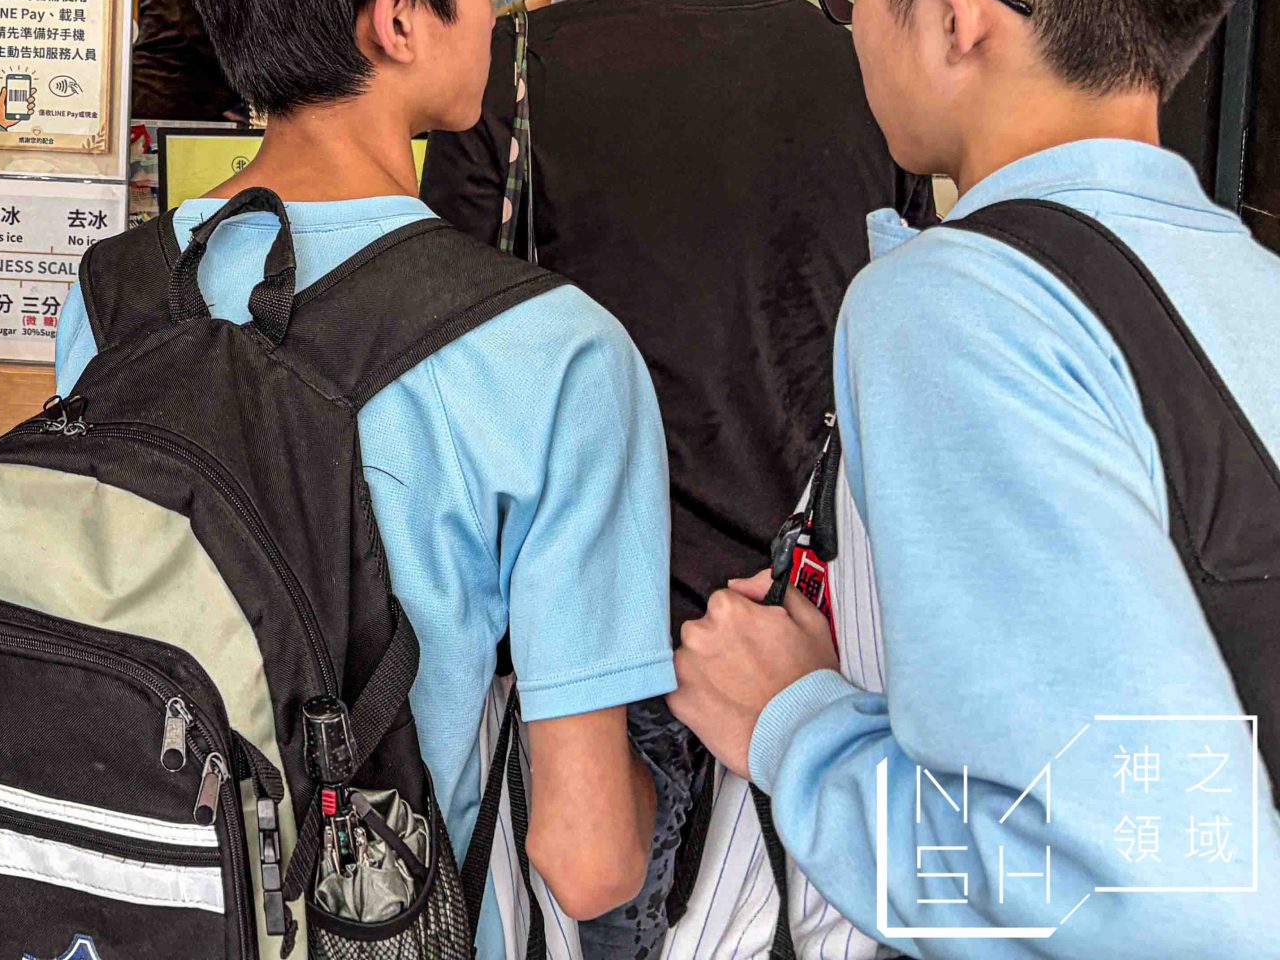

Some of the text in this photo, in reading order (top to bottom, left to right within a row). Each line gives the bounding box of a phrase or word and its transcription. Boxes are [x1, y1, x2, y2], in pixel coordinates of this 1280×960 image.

[68, 209, 108, 230] 去冰
[7, 233, 23, 242] ice
[68, 235, 83, 246] No
[38, 262, 80, 275] SCAL
[21, 297, 60, 316] 三分
[22, 328, 56, 338] 30%Sug
